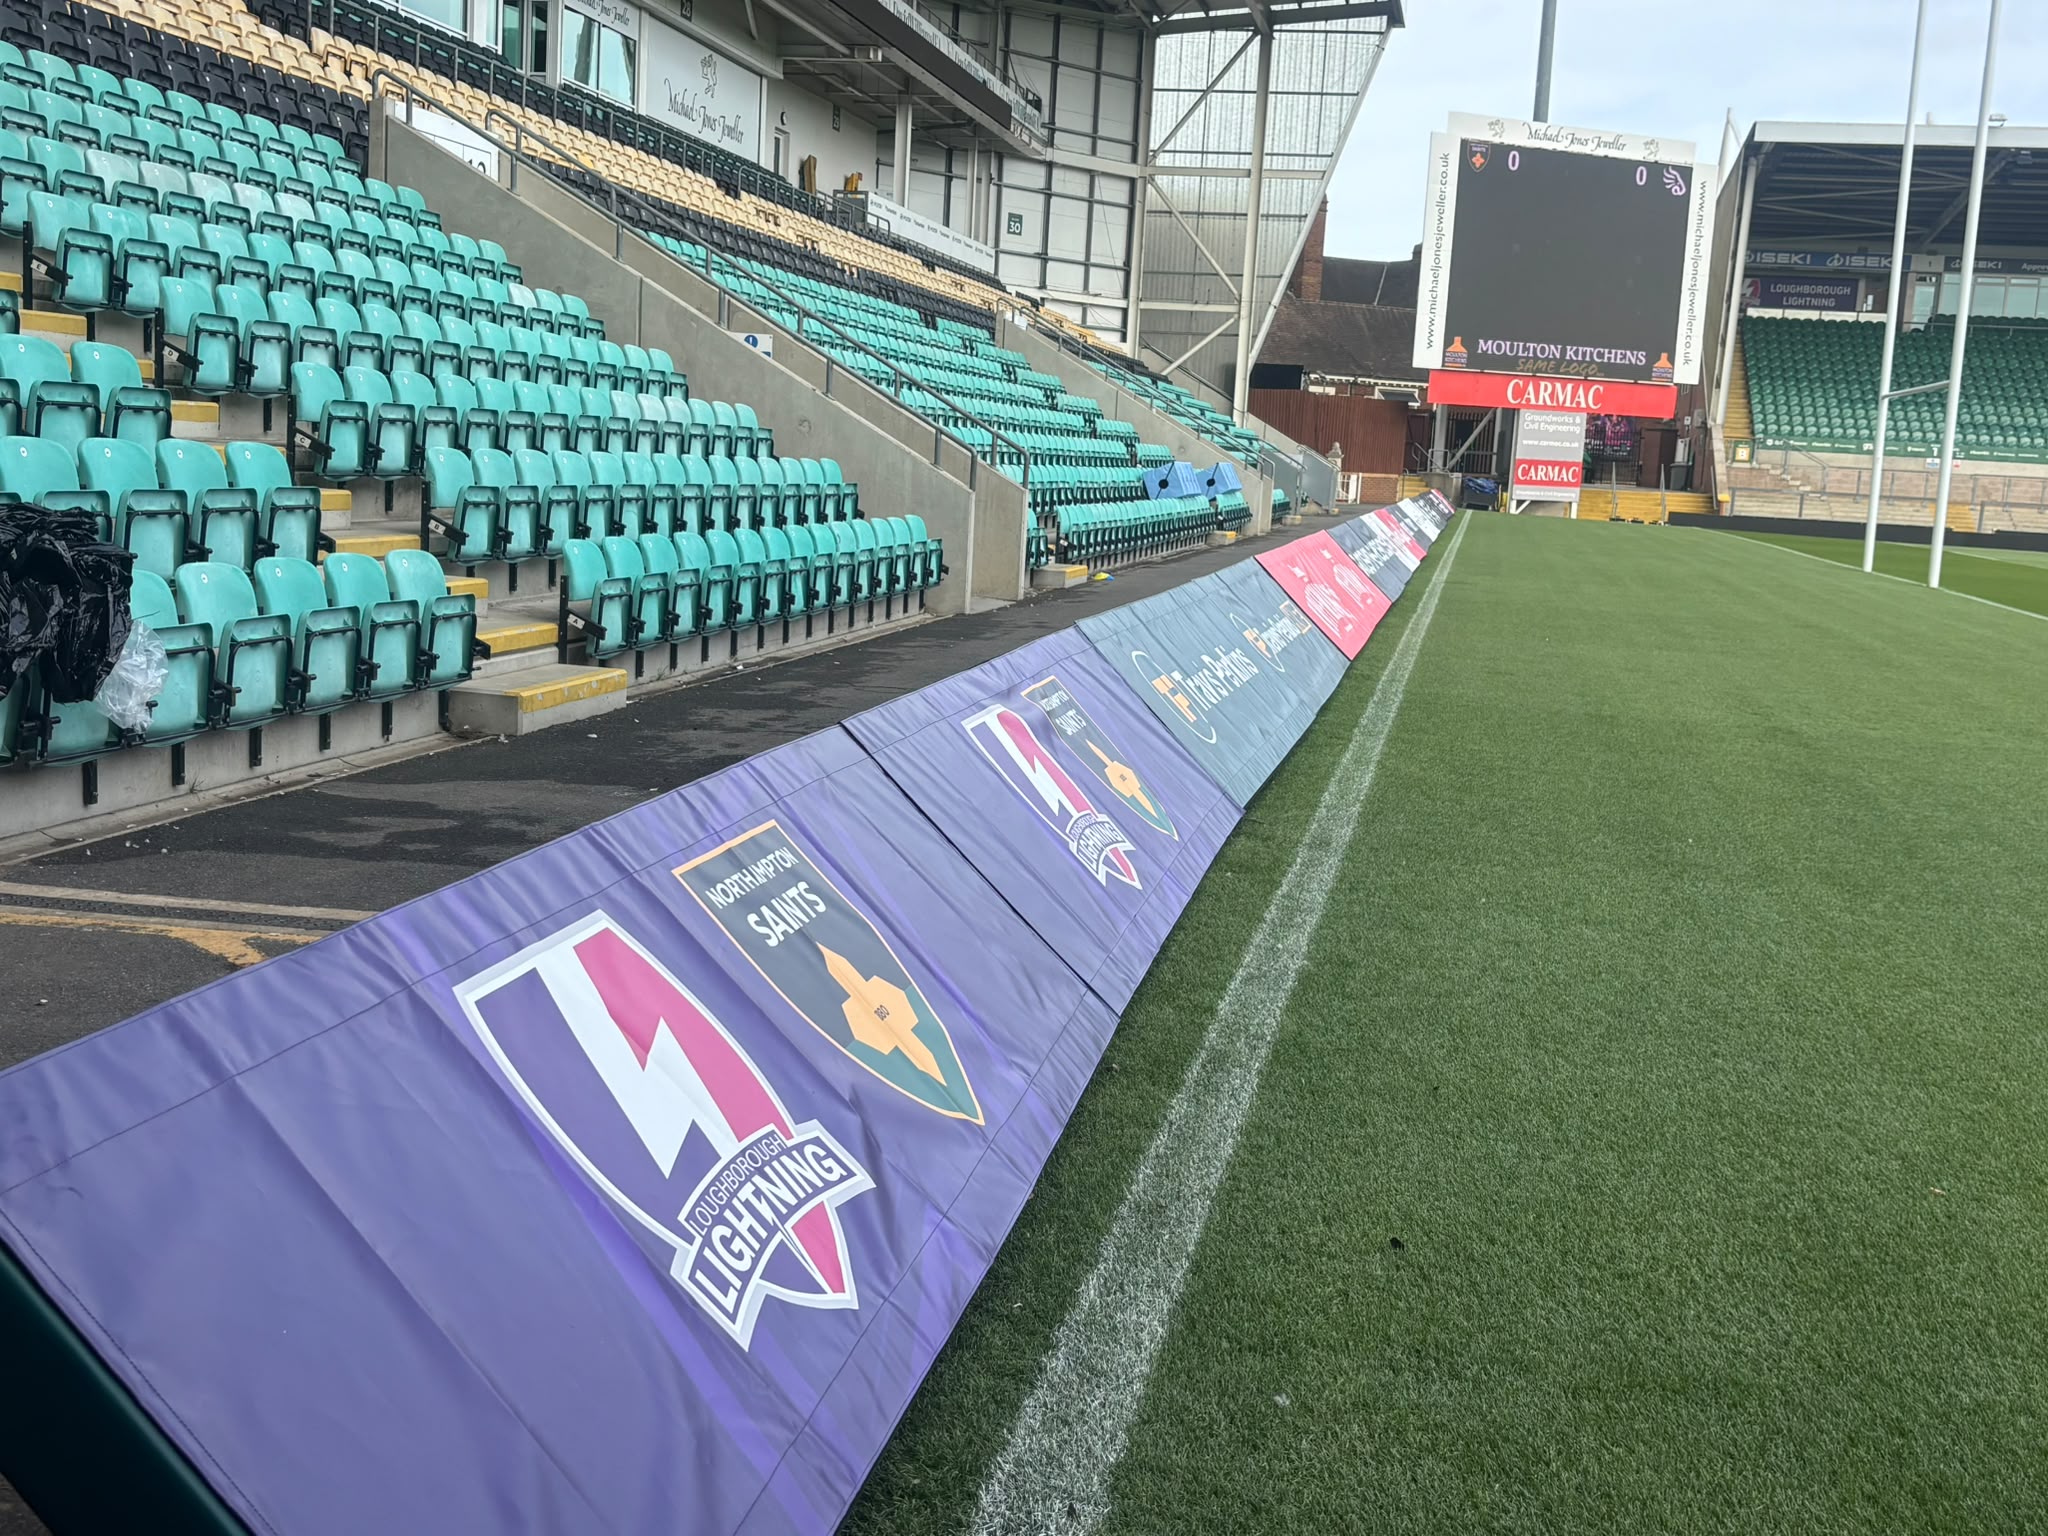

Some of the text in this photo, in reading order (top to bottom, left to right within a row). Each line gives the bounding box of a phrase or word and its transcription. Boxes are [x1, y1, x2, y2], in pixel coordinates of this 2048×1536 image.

[664, 77, 744, 144] Michael Jones Jeweller
[1522, 122, 1627, 152] Michael Jones Jeweller
[1508, 151, 1519, 171] 0
[1636, 166, 1647, 185] 0
[1009, 221, 1021, 233] 30
[1426, 152, 1449, 350] www.michaeljonesjeweller.co.uk
[1756, 252, 1812, 264] ISEKI
[1845, 255, 1893, 267] ISEK
[1683, 181, 1707, 366] www.michaeljonesjeweller.co.uk
[1770, 284, 1851, 295] LOUGHBOROUGH
[1783, 297, 1835, 307] LIGHTNING
[1477, 339, 1646, 366] MOULTON KITCHENS
[1506, 379, 1603, 409] CARMAC
[1523, 421, 1580, 434] Civil Engineering
[1524, 412, 1573, 423] Groundworks
[1517, 464, 1578, 483] CARMAC
[1171, 645, 1259, 711] Travis Perkins
[1055, 708, 1087, 736] SAINTS
[1078, 820, 1126, 874] LIGHTNING
[705, 847, 800, 909] NORTHAMPTON
[746, 881, 827, 947] SAINTS
[689, 1134, 787, 1237] LOUGHBOROUGH
[694, 1143, 848, 1314] LIGHTNING
